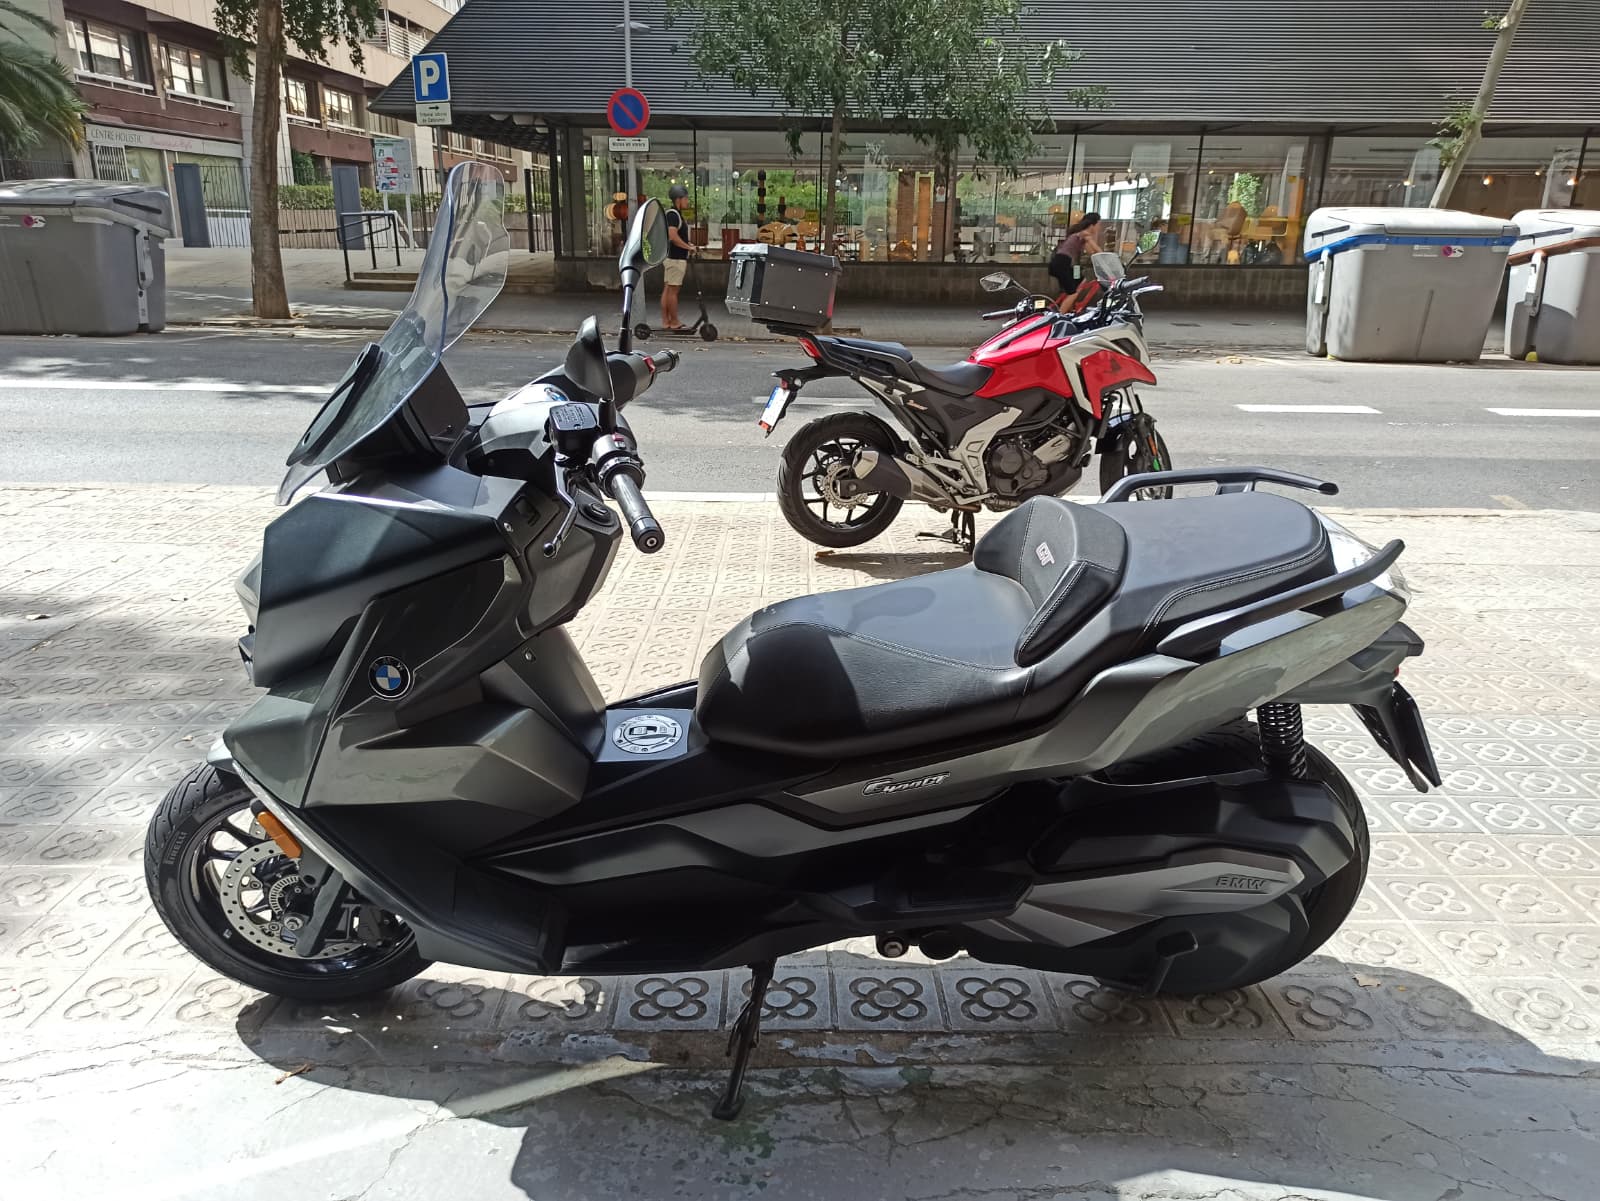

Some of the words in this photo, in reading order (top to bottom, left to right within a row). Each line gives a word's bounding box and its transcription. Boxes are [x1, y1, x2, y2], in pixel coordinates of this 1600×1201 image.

[419, 60, 440, 97] P
[90, 129, 114, 142] CENTRE
[1035, 541, 1055, 566] GT
[163, 831, 188, 865] PIRELLI
[1215, 876, 1265, 889] BMW
